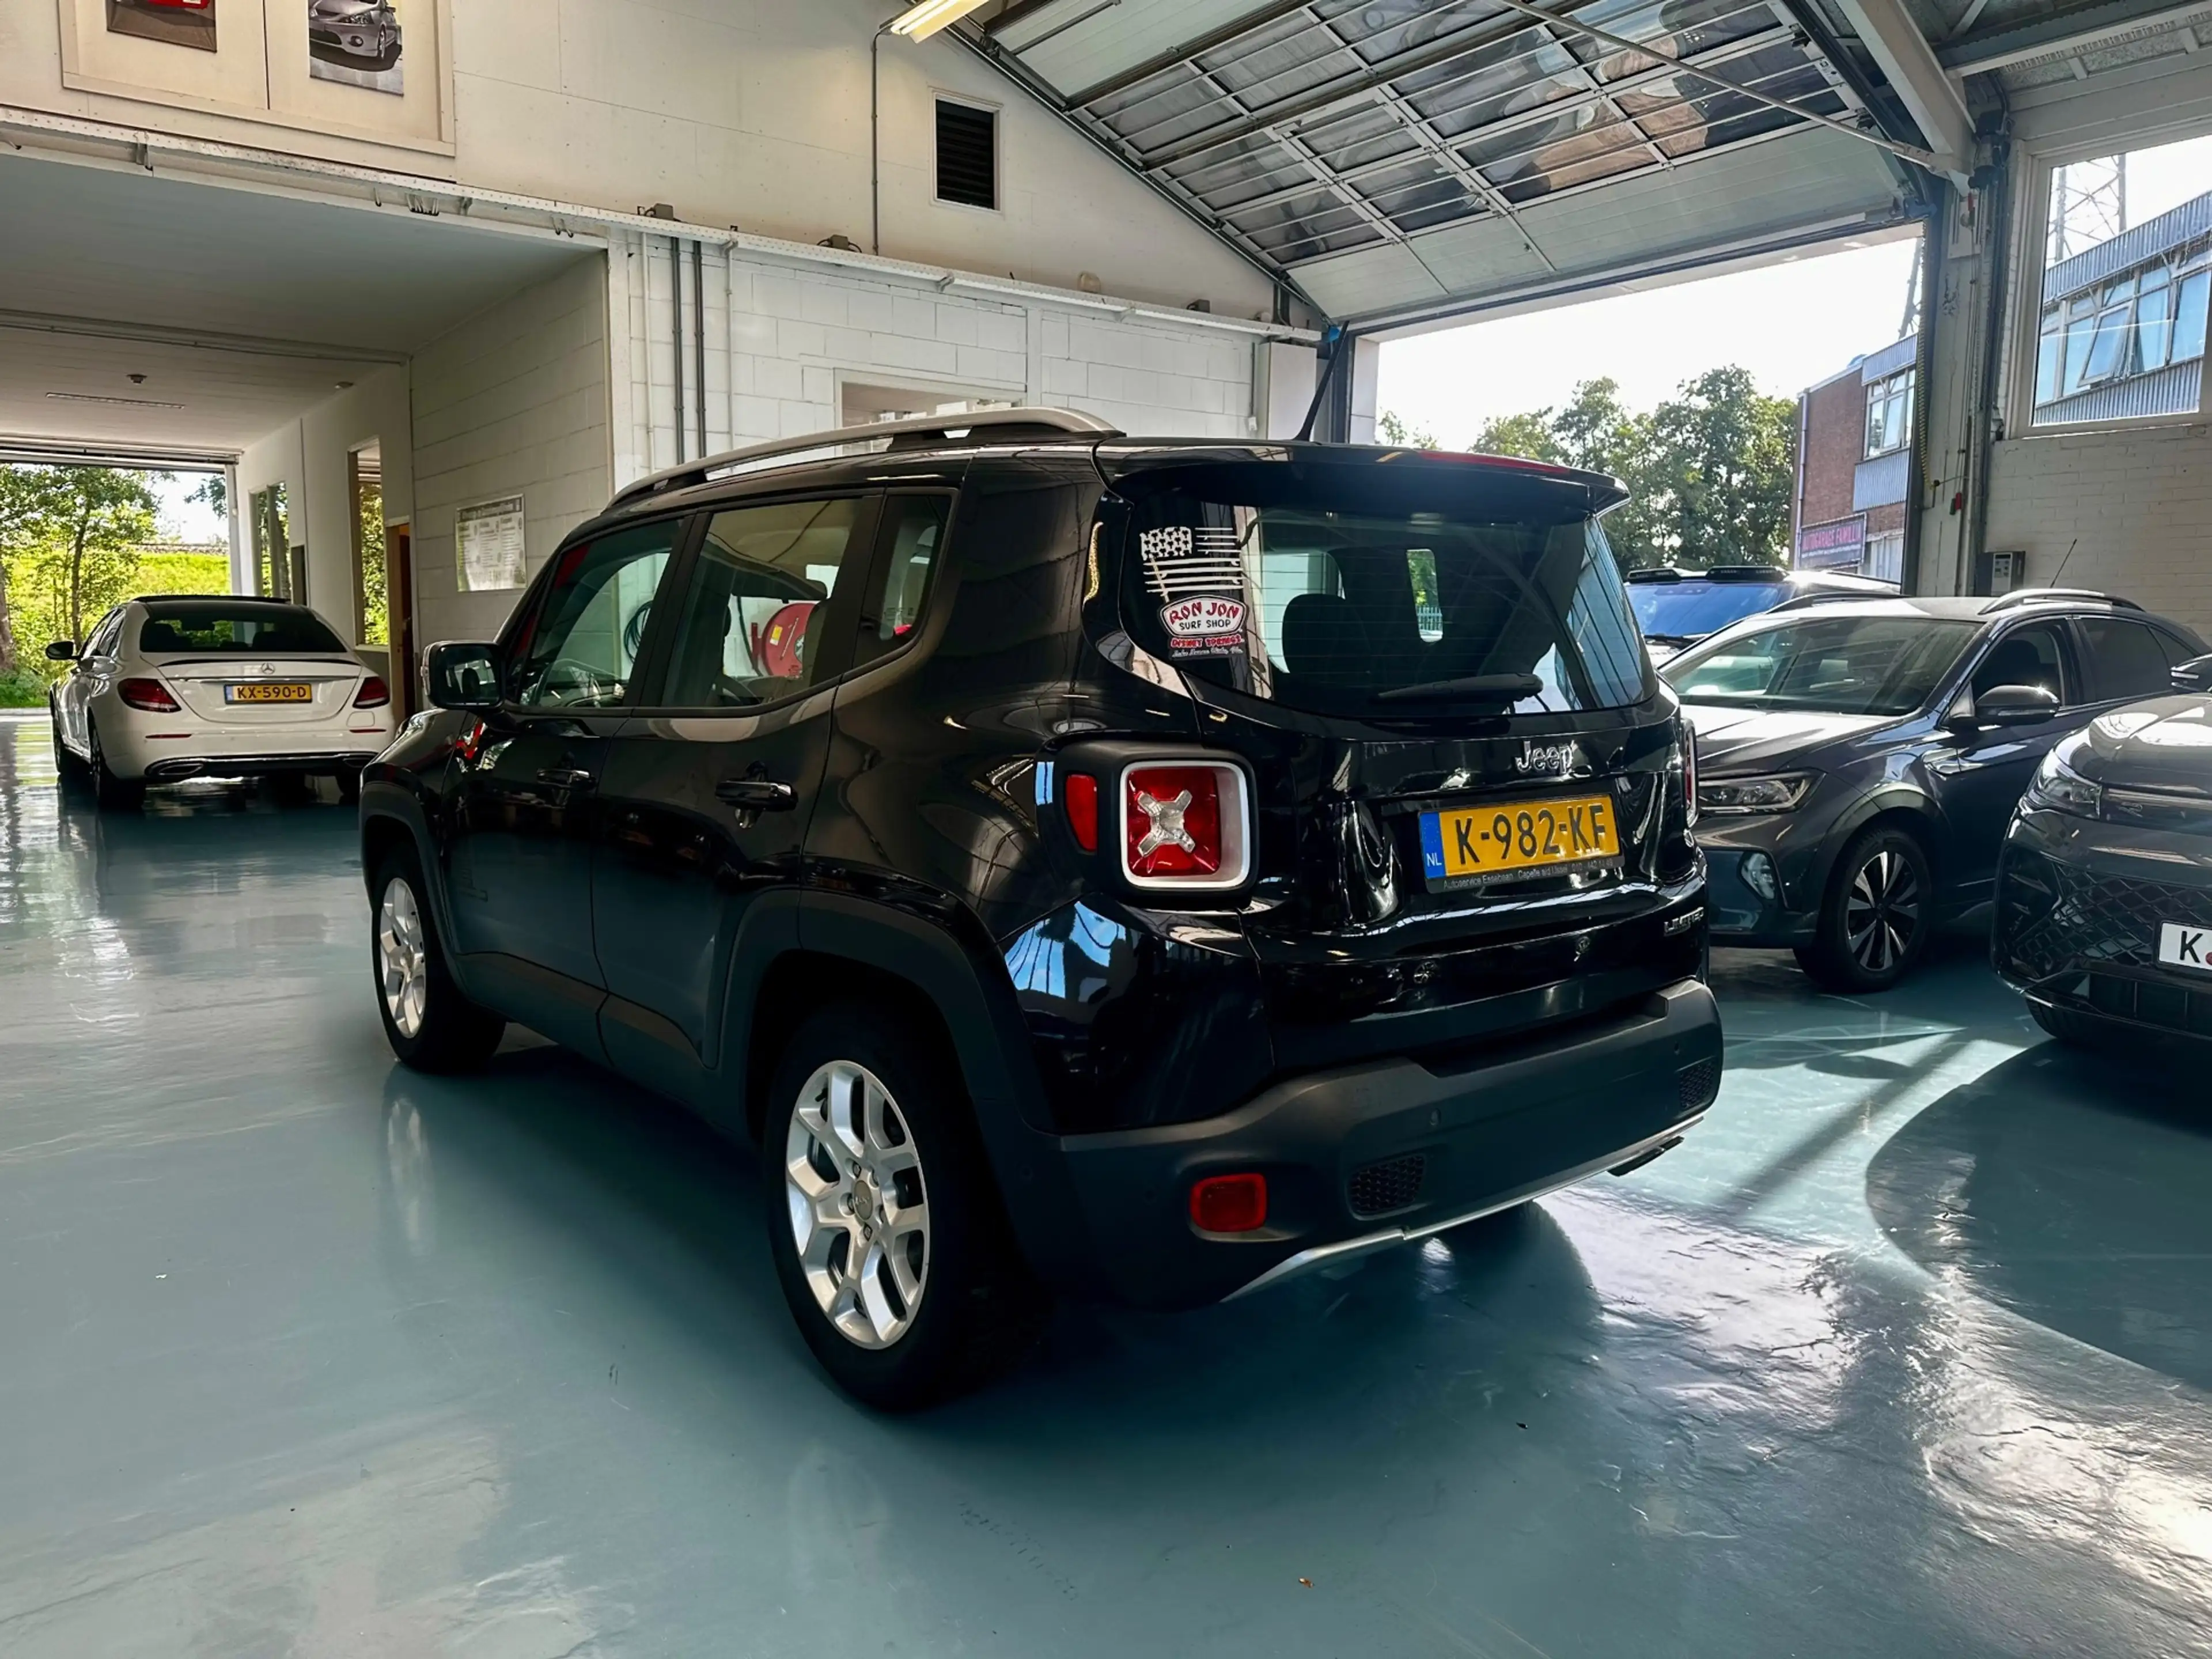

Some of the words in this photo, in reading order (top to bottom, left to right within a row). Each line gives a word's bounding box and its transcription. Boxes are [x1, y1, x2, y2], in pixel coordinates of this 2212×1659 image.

[1169, 601, 1202, 625] RON
[1206, 603, 1239, 618] JON
[1179, 620, 1202, 631] SURF
[1206, 619, 1232, 628] SHOP
[237, 686, 306, 699] KX-590-D
[1514, 740, 1574, 774] Jeep
[1455, 803, 1606, 865] K-982-KF
[1426, 853, 1442, 867] NL
[1444, 876, 1482, 890] Autoservice
[1518, 868, 1540, 880] Capelle
[2179, 931, 2203, 963] K
